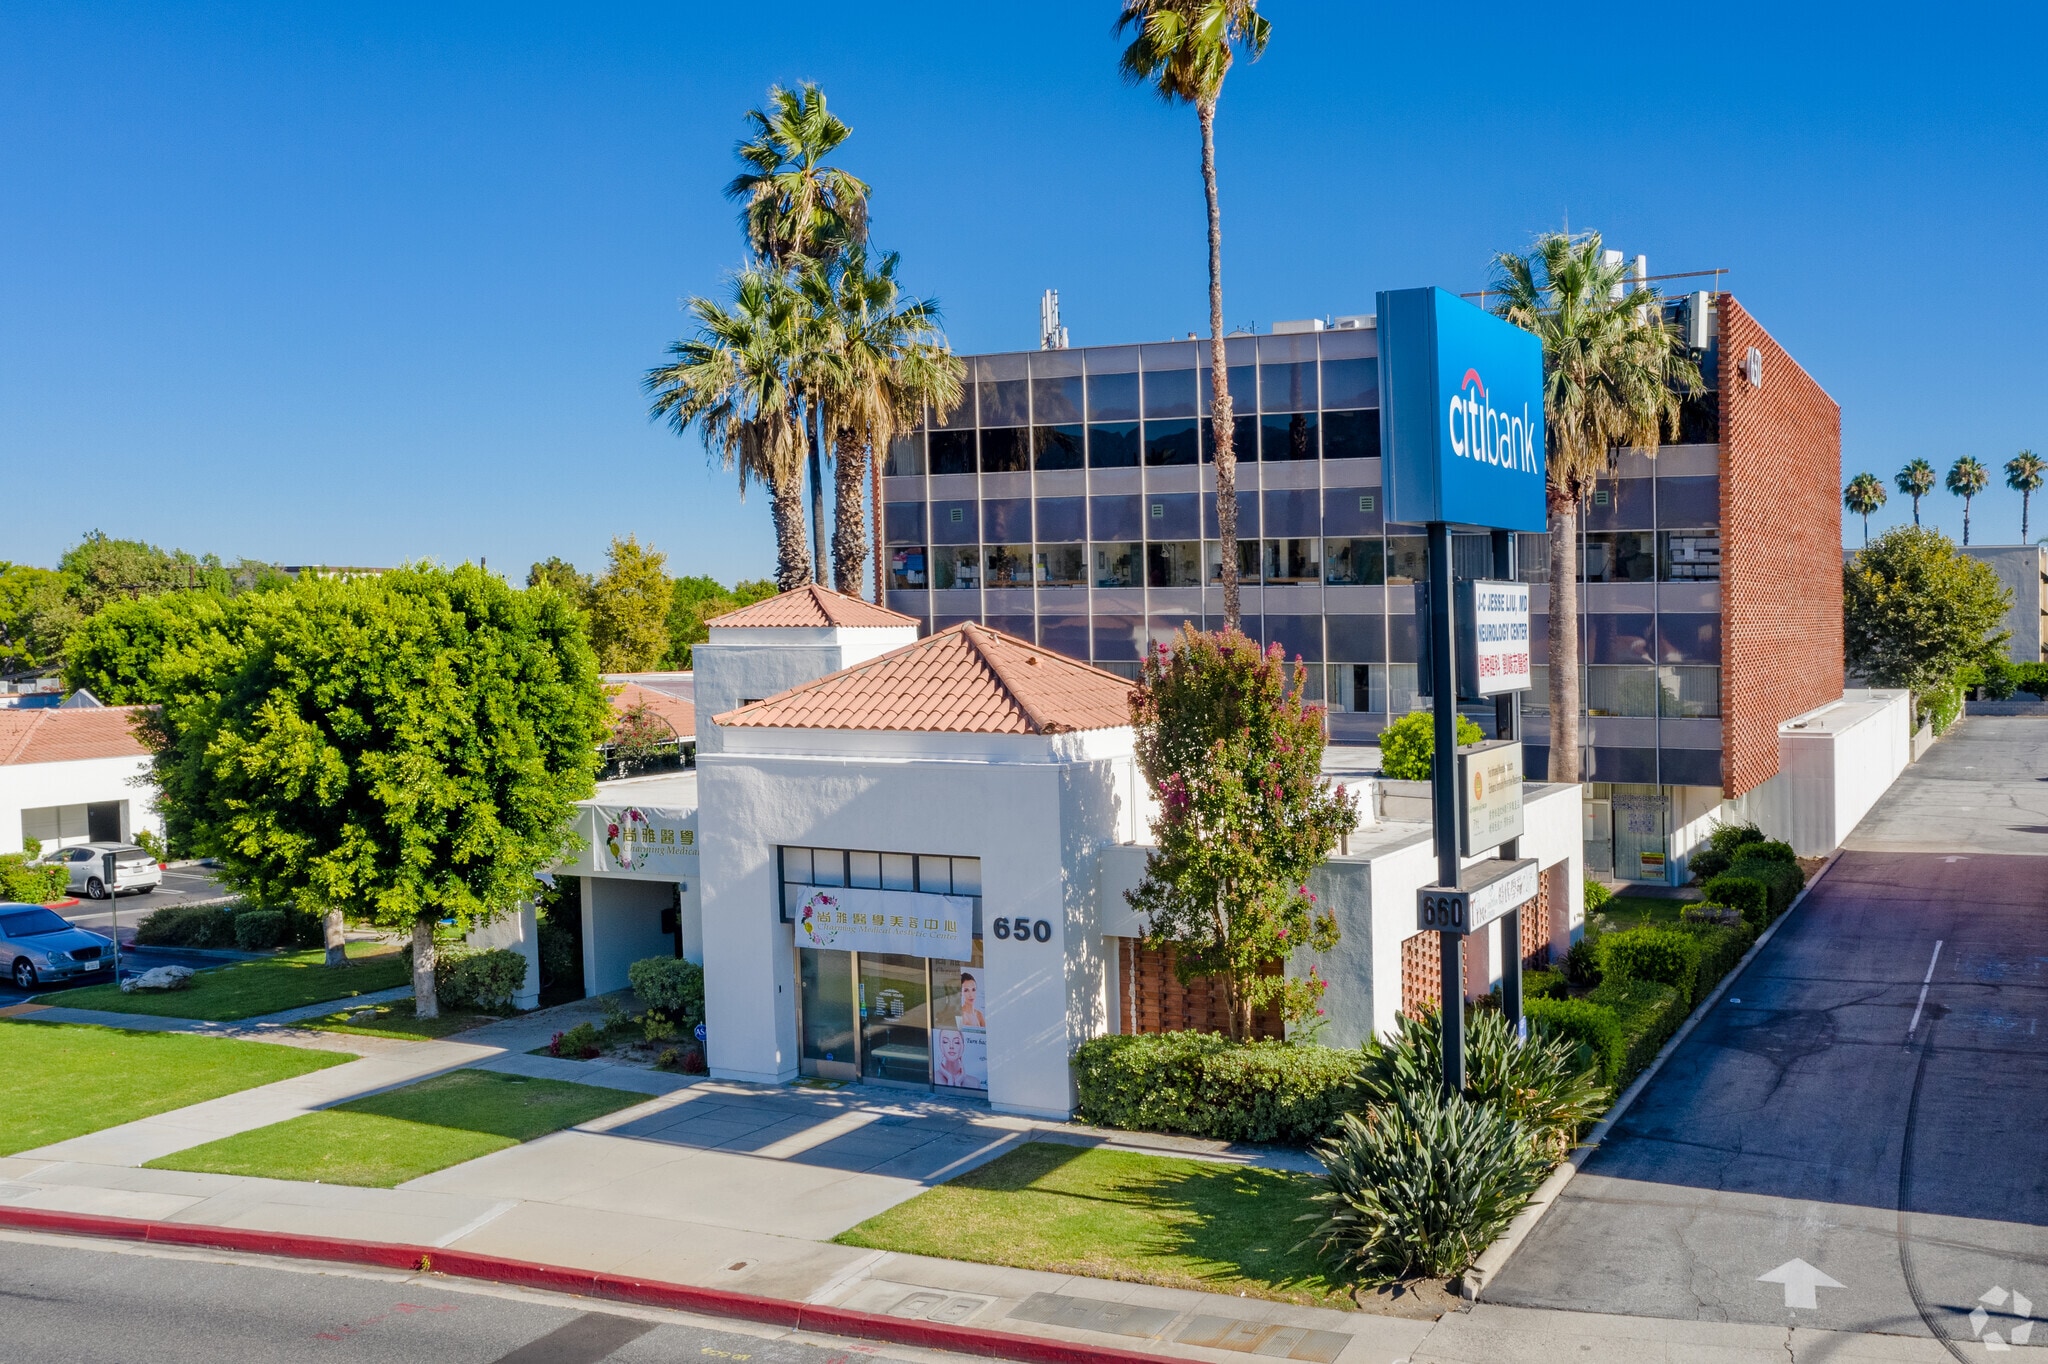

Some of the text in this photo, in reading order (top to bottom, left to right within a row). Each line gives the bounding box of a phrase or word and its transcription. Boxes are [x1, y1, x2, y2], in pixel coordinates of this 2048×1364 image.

[1449, 385, 1538, 475] citibank
[1487, 593, 1505, 611] JESSE
[1519, 594, 1528, 612] MD
[1478, 623, 1528, 642] NEUROLOGY CENTER
[624, 845, 665, 856] Charming
[817, 924, 957, 941] Charming Medical Aesthetic Center
[993, 917, 1052, 943] 650
